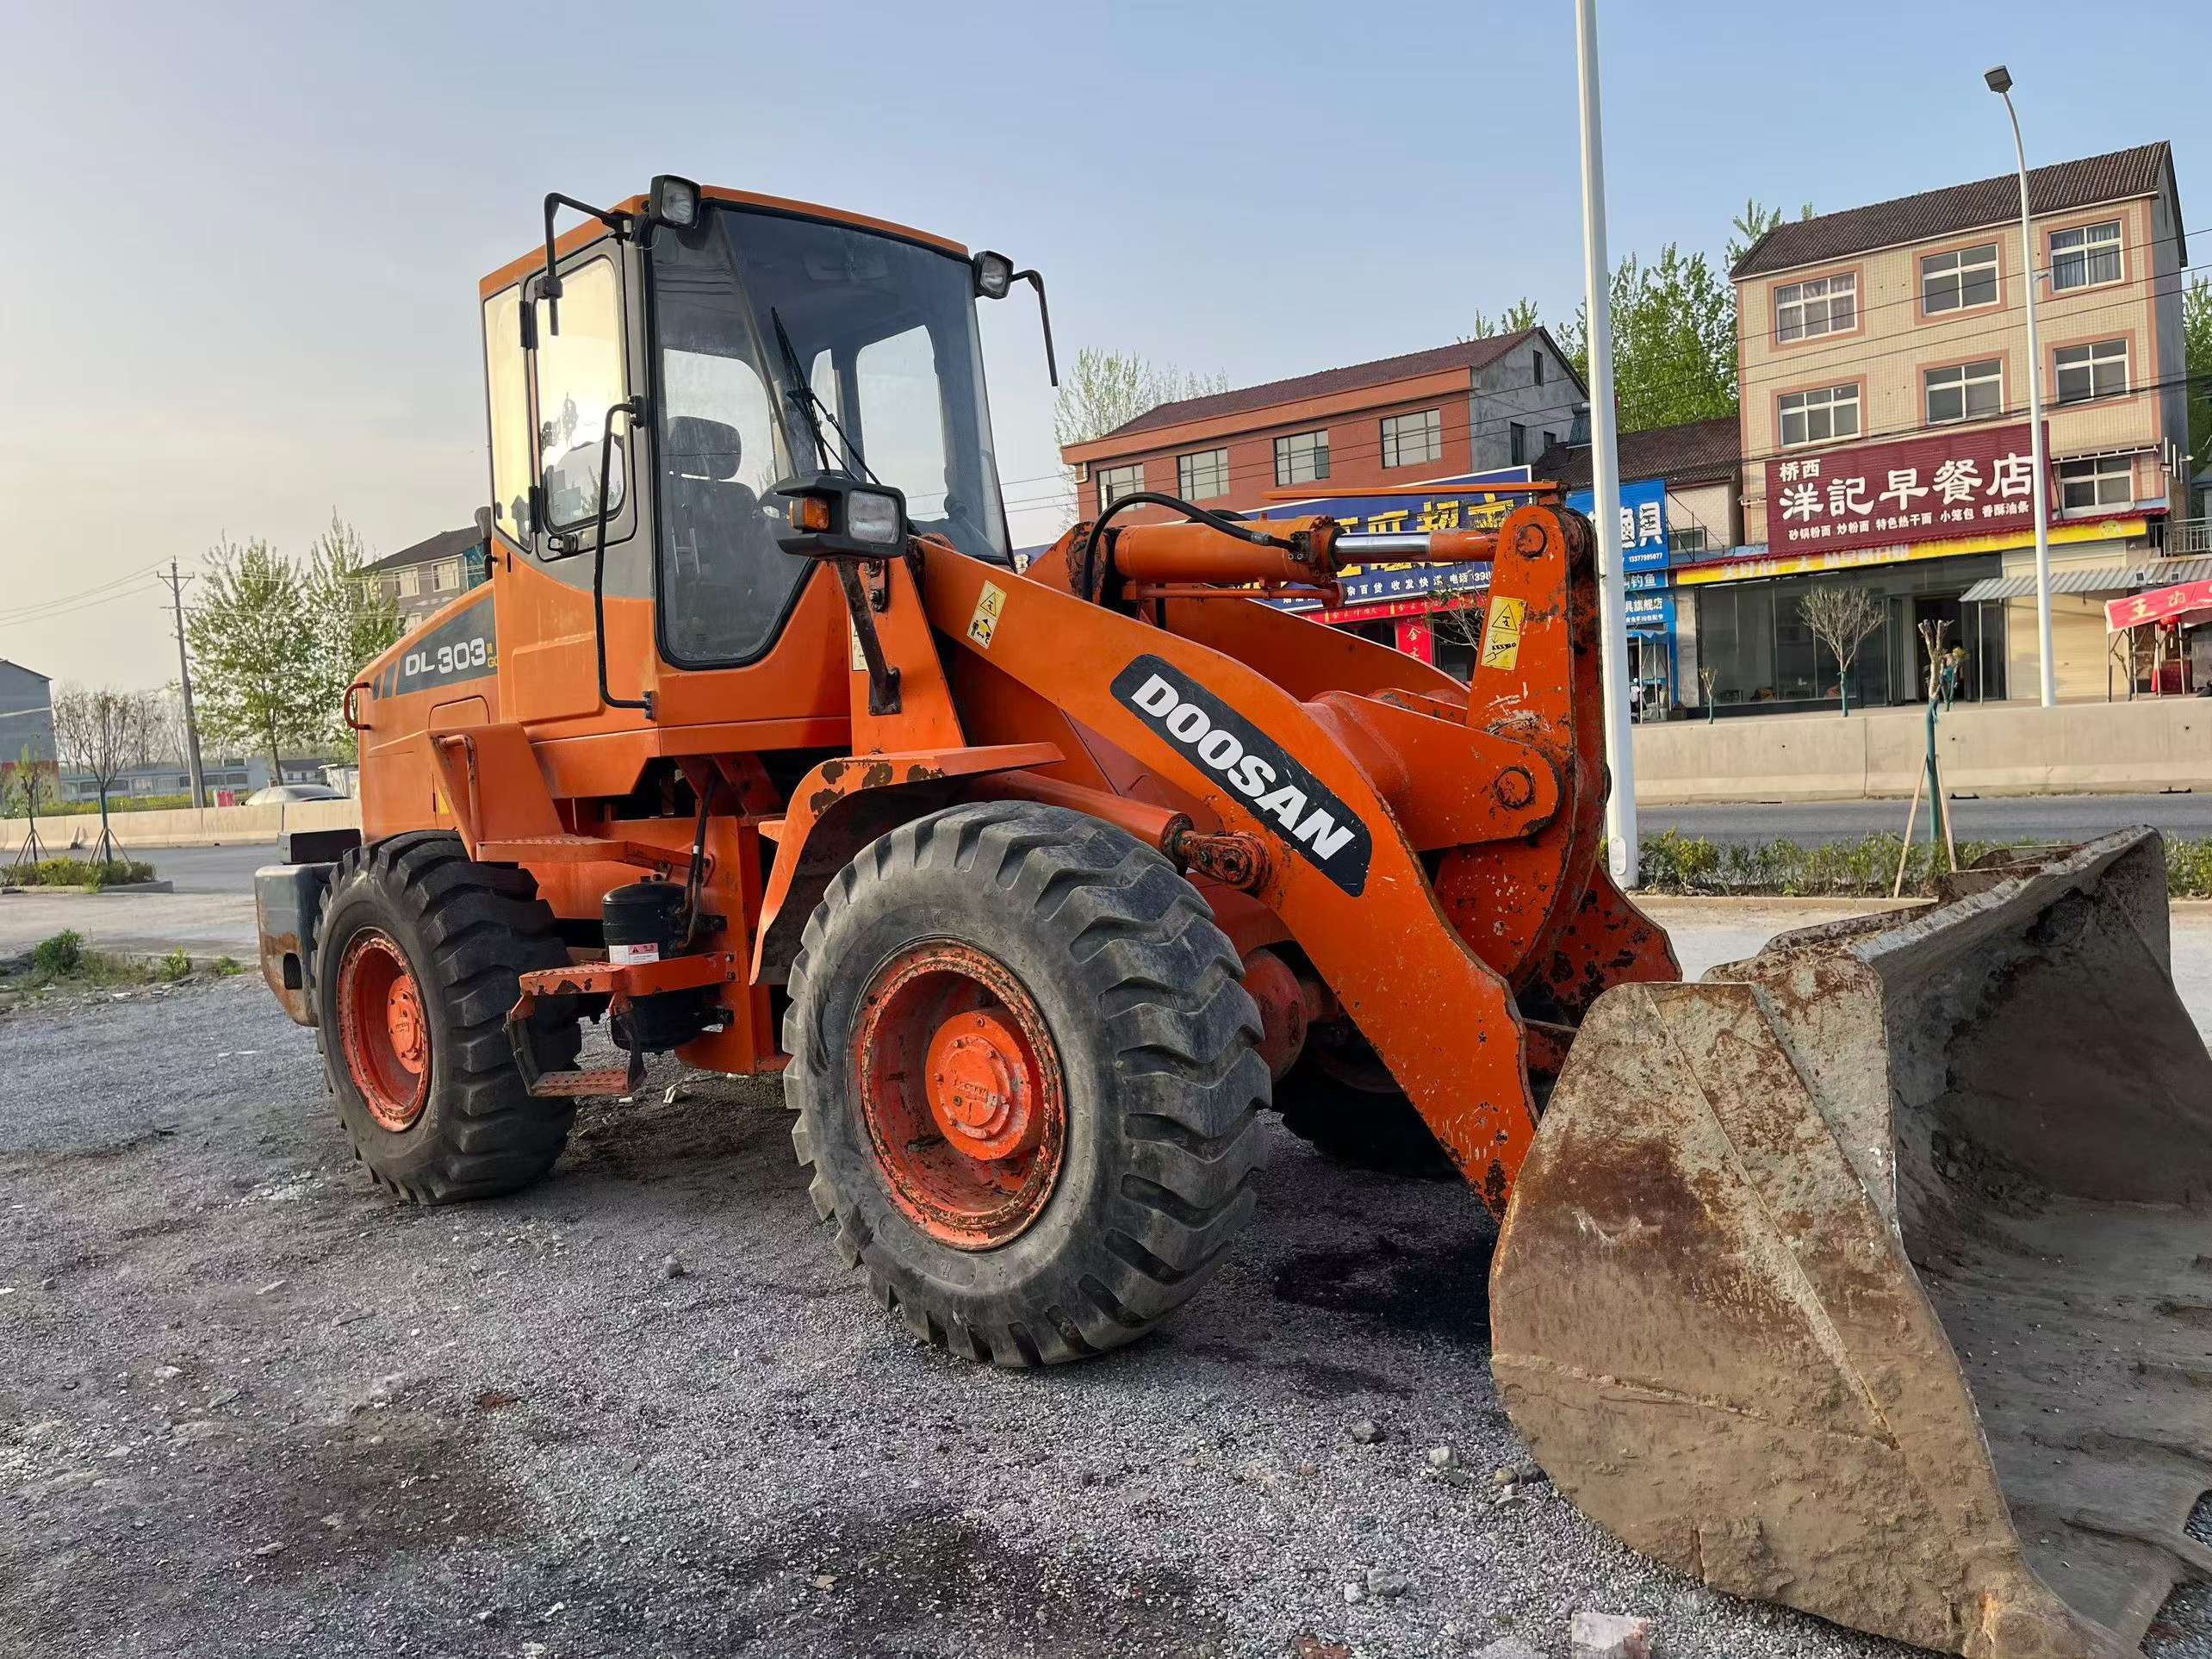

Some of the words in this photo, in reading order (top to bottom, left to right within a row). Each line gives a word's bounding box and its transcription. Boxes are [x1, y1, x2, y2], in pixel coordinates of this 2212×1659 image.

[1779, 458, 1821, 482] 桥西
[1779, 453, 2034, 522] 洋記早餐店
[1788, 525, 1831, 541] 砂锅粉面
[1836, 520, 1869, 535] 炒粉面
[1875, 512, 1932, 531] 特色热干面
[1940, 507, 1974, 523] 小笼包
[1982, 500, 2029, 519] 香酥油条
[1624, 573, 1656, 588] 钓鱼
[405, 637, 486, 676] DL303
[1130, 673, 1356, 861] DOOSAN
